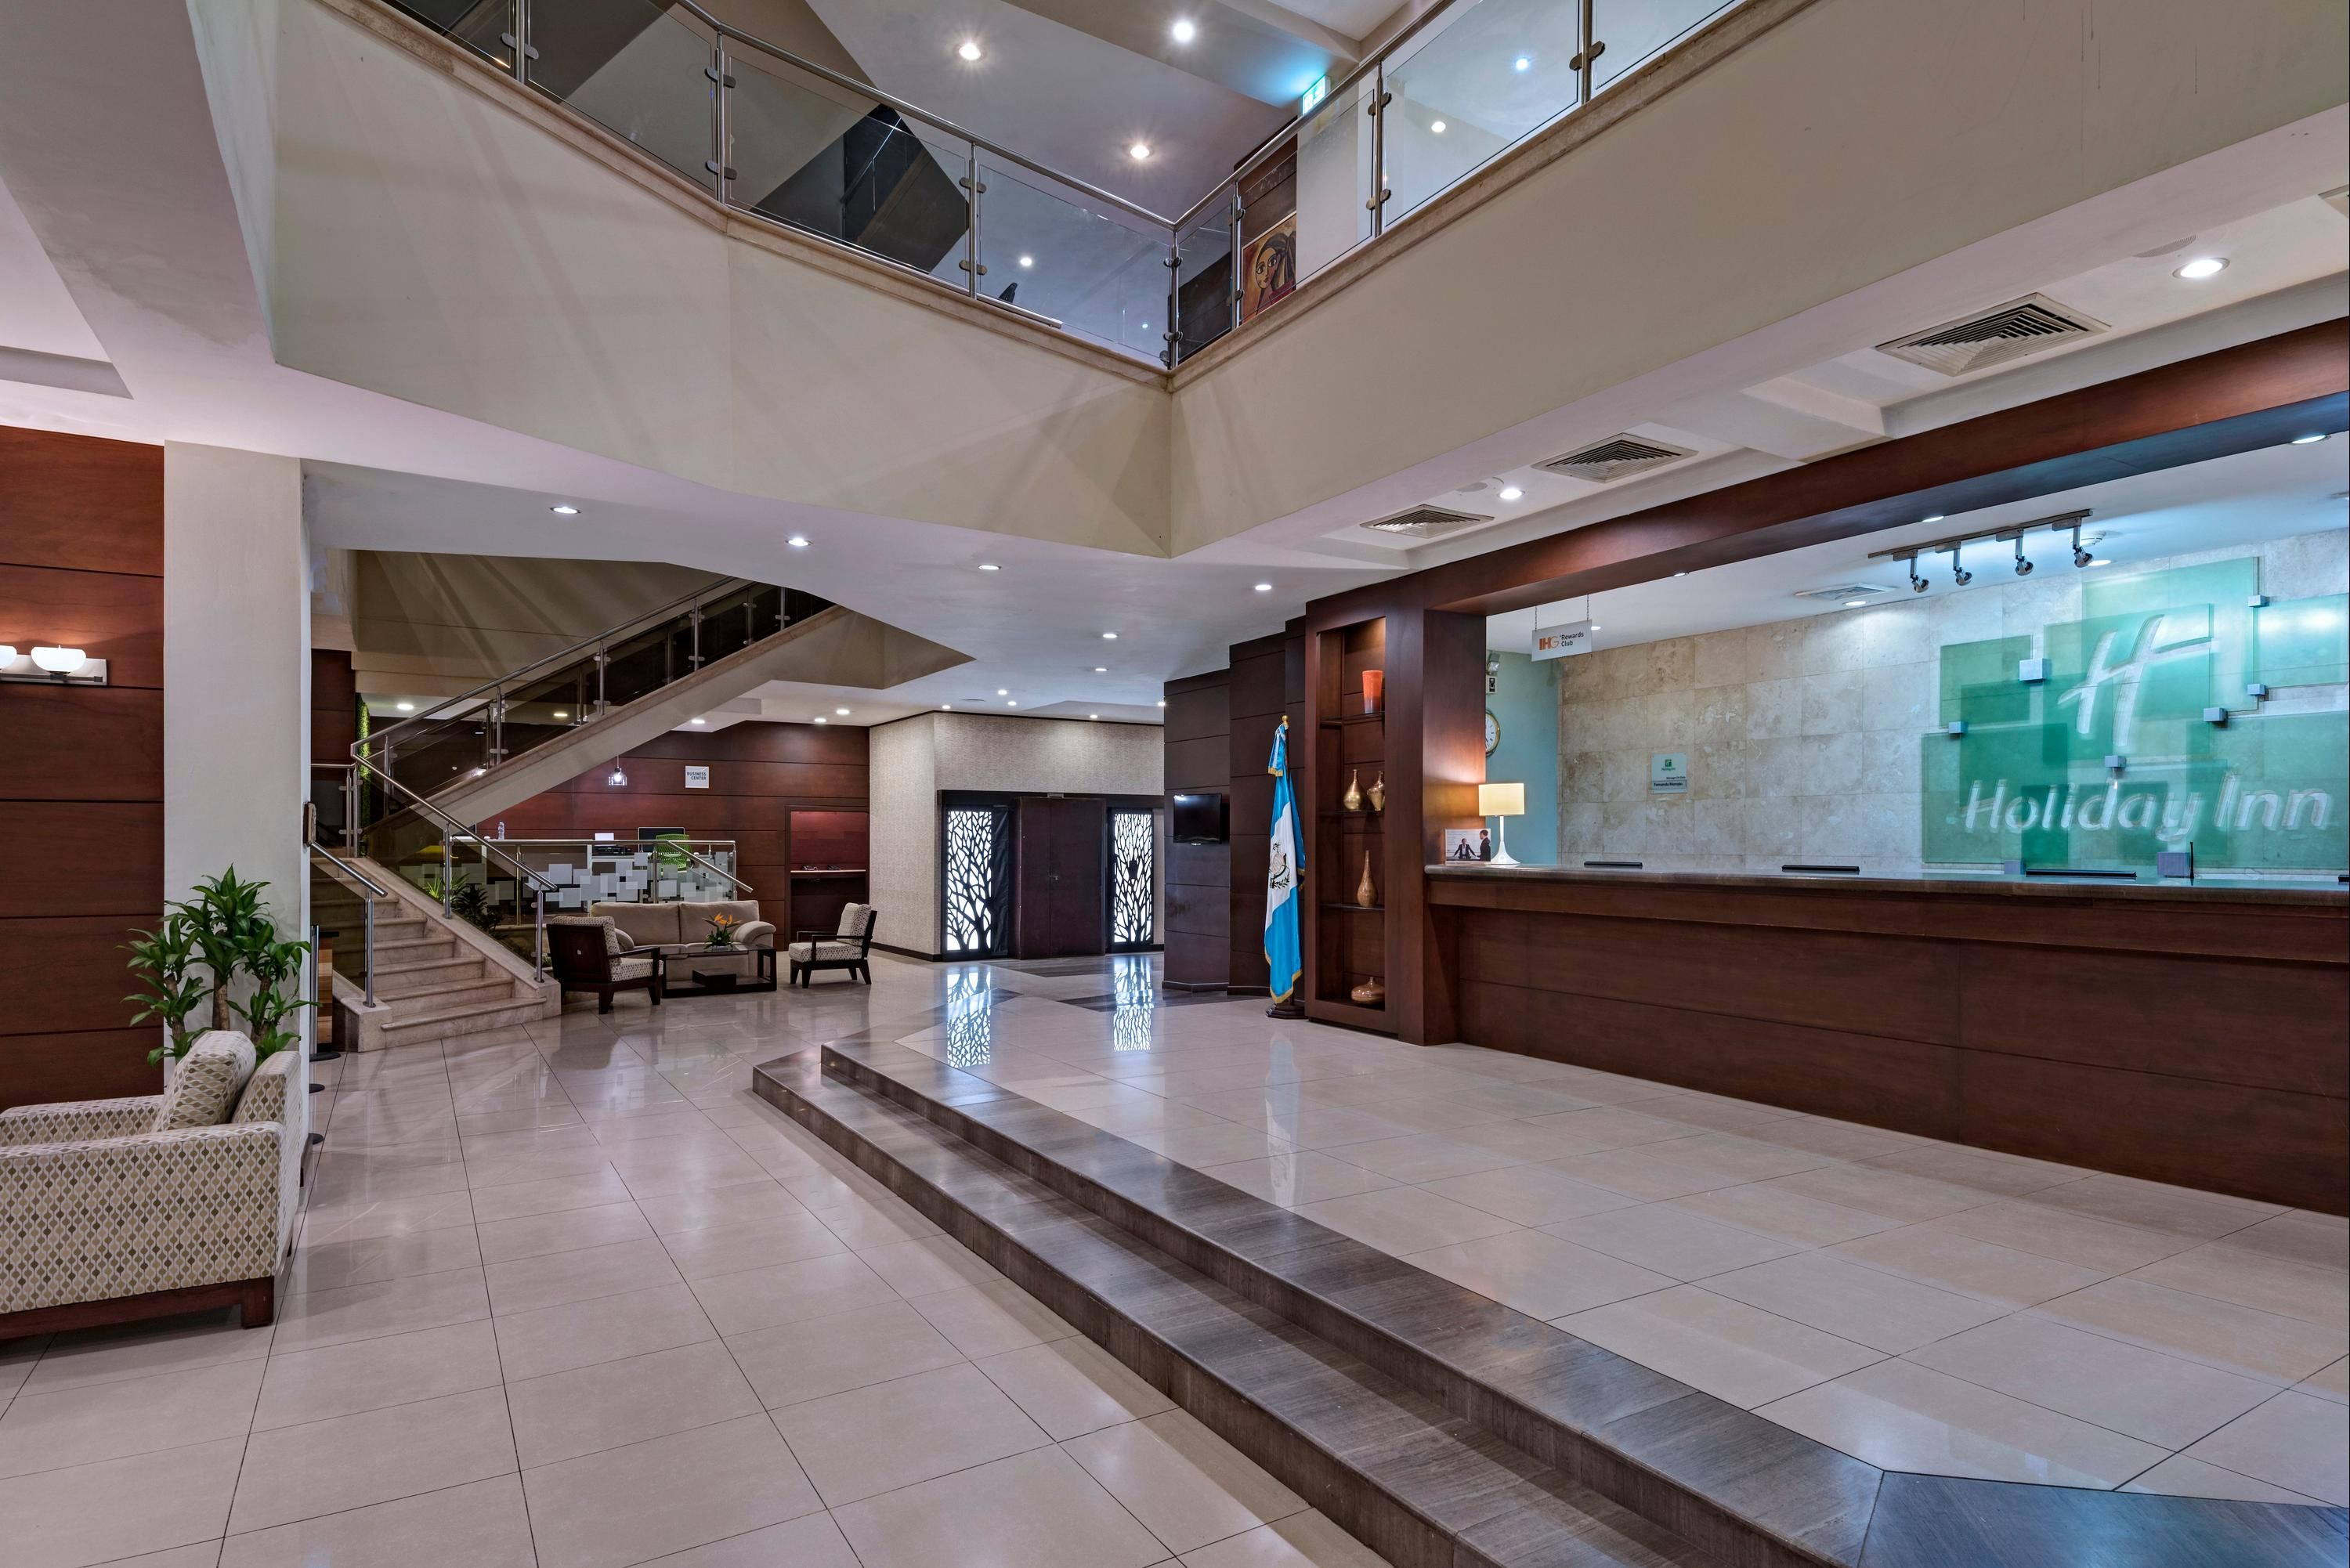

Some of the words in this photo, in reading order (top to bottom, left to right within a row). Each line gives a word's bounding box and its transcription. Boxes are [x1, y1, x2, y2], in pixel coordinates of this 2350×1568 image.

[1561, 631, 1584, 640] Rewards
[1959, 778, 2200, 842] Holiday
[2214, 771, 2332, 831] Inn
